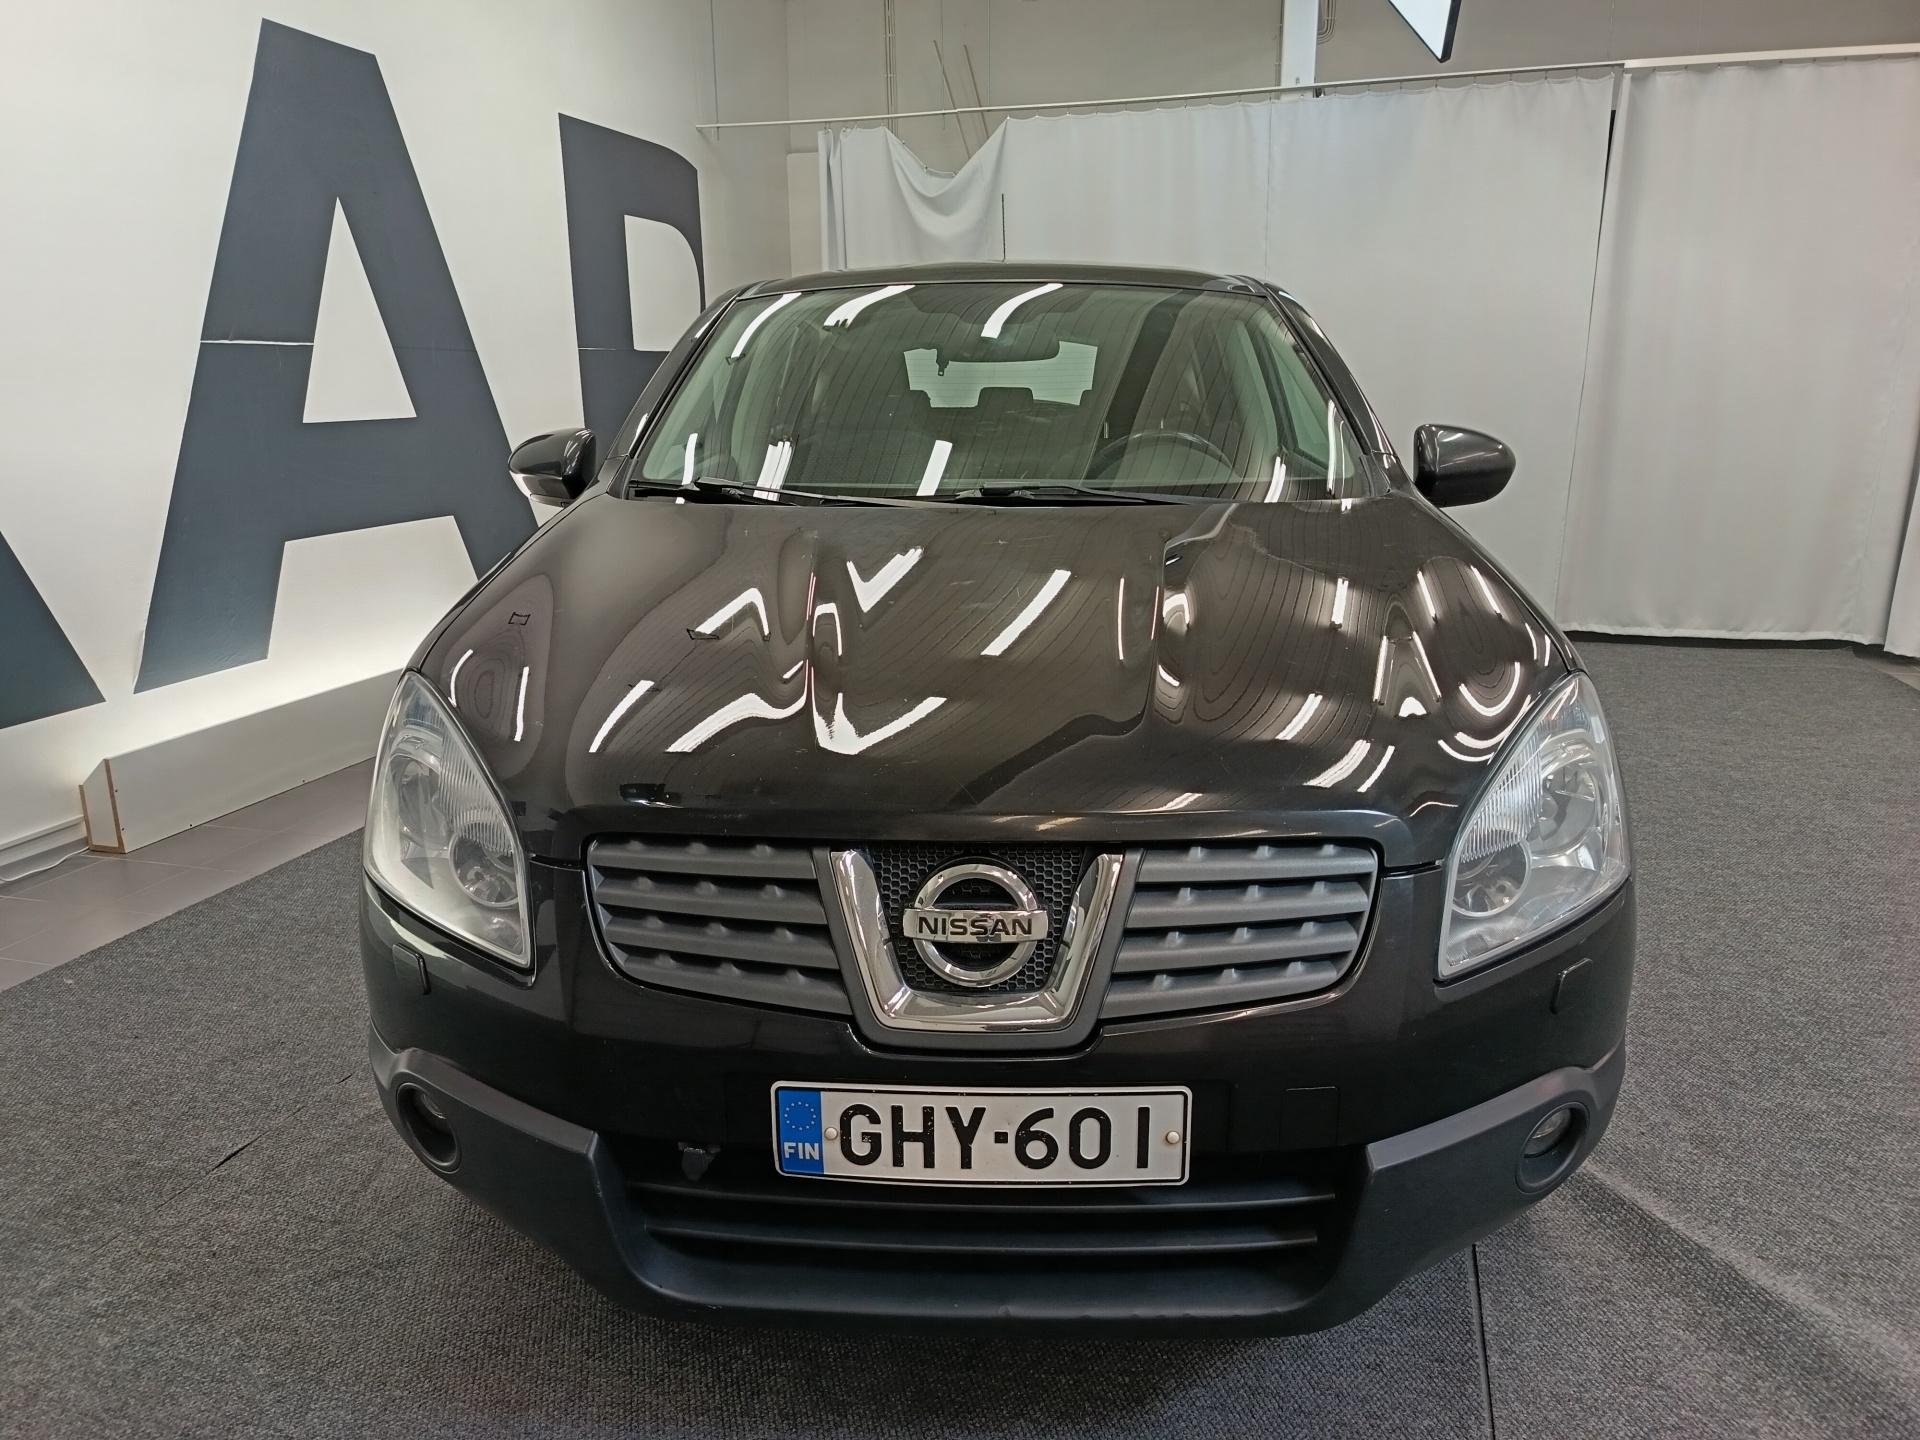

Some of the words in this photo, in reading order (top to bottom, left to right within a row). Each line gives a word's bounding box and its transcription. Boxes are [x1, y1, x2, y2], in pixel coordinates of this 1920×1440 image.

[918, 916, 1033, 936] NISSAN
[840, 1103, 1150, 1170] GHY-601
[783, 1141, 820, 1161] FIN
